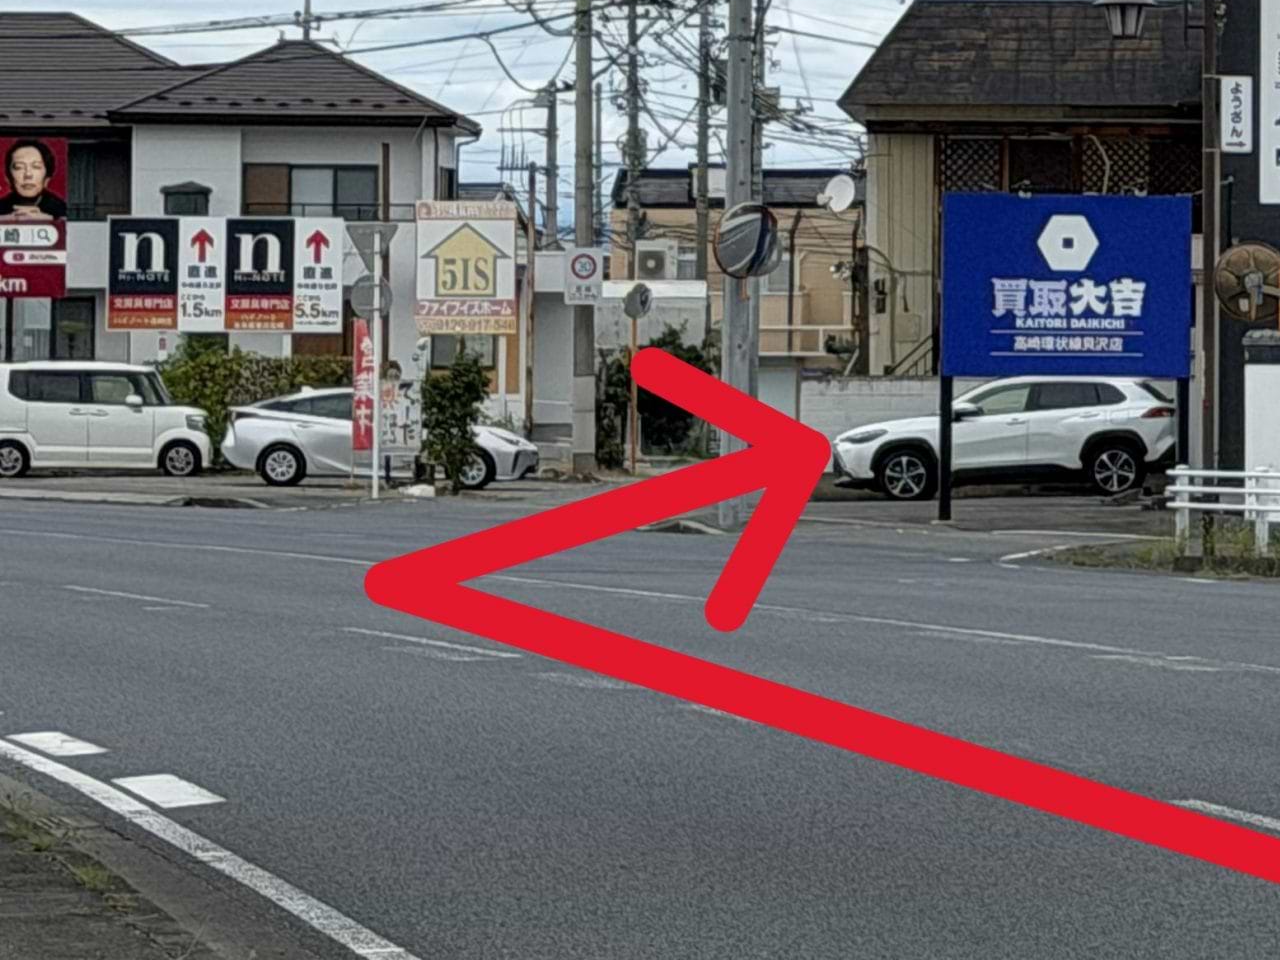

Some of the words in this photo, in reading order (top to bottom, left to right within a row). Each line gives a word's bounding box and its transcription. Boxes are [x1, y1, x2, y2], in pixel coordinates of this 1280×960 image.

[991, 278, 1146, 317] 買取大吉
[1015, 318, 1067, 329] KAITORI
[1070, 318, 1125, 329] DAIKICHI
[1014, 335, 1124, 352] 高崎環状線貝沢店
